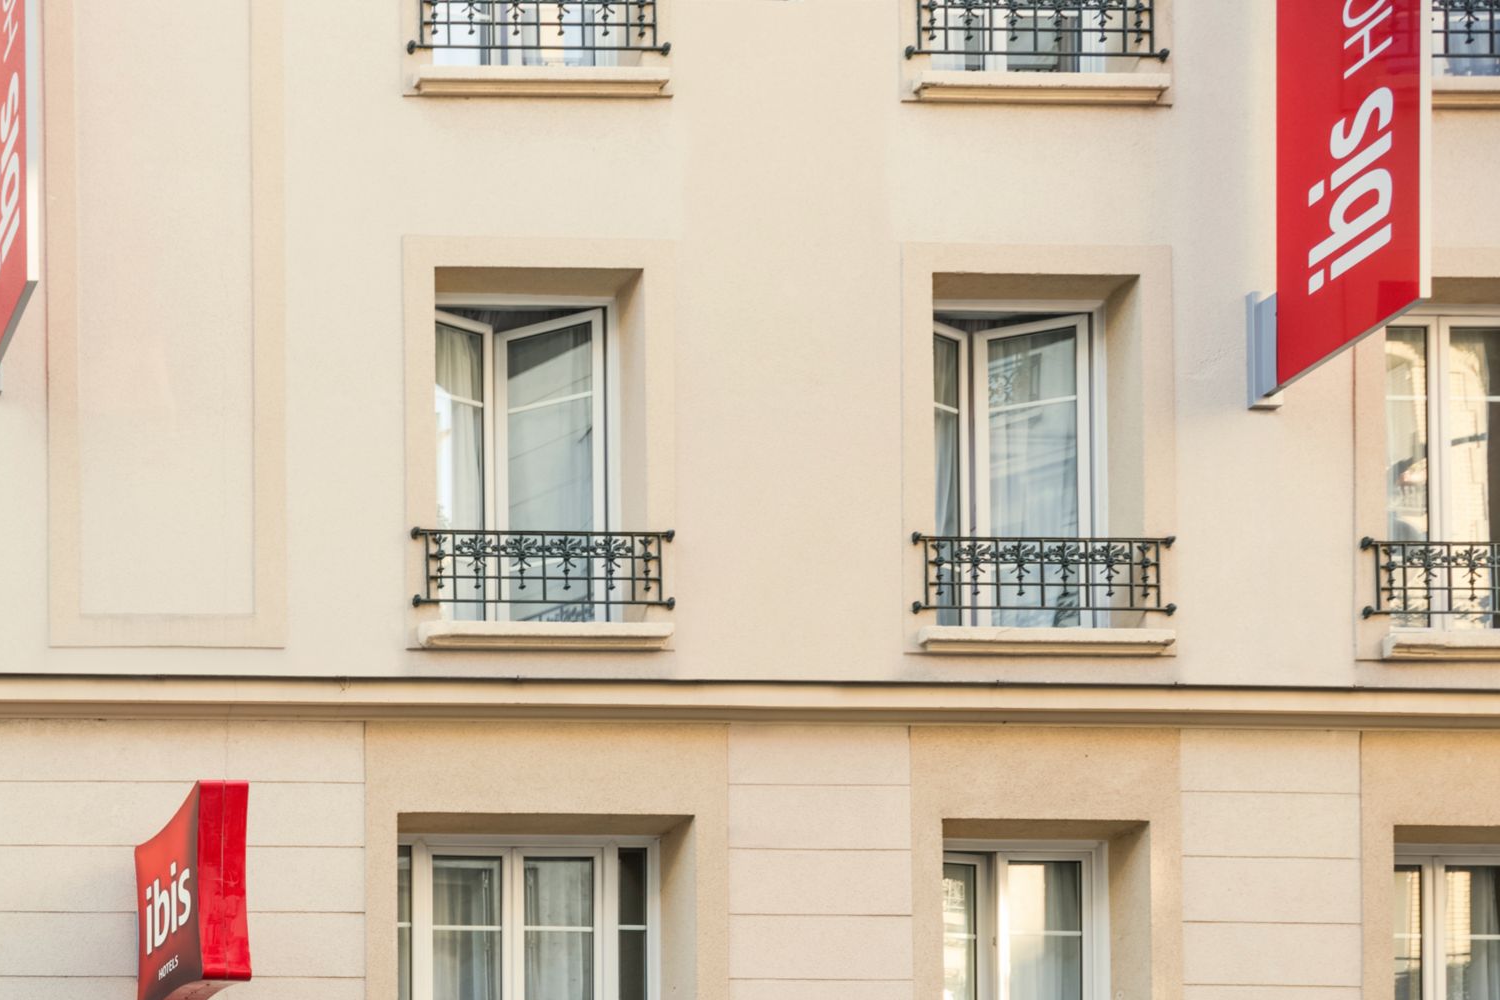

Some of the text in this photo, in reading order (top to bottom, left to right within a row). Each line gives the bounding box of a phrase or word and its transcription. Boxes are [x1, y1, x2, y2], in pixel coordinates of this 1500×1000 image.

[3, 0, 18, 63] H
[1308, 86, 1394, 296] ibis
[146, 861, 191, 955] ibis
[158, 955, 179, 981] HOTELS
